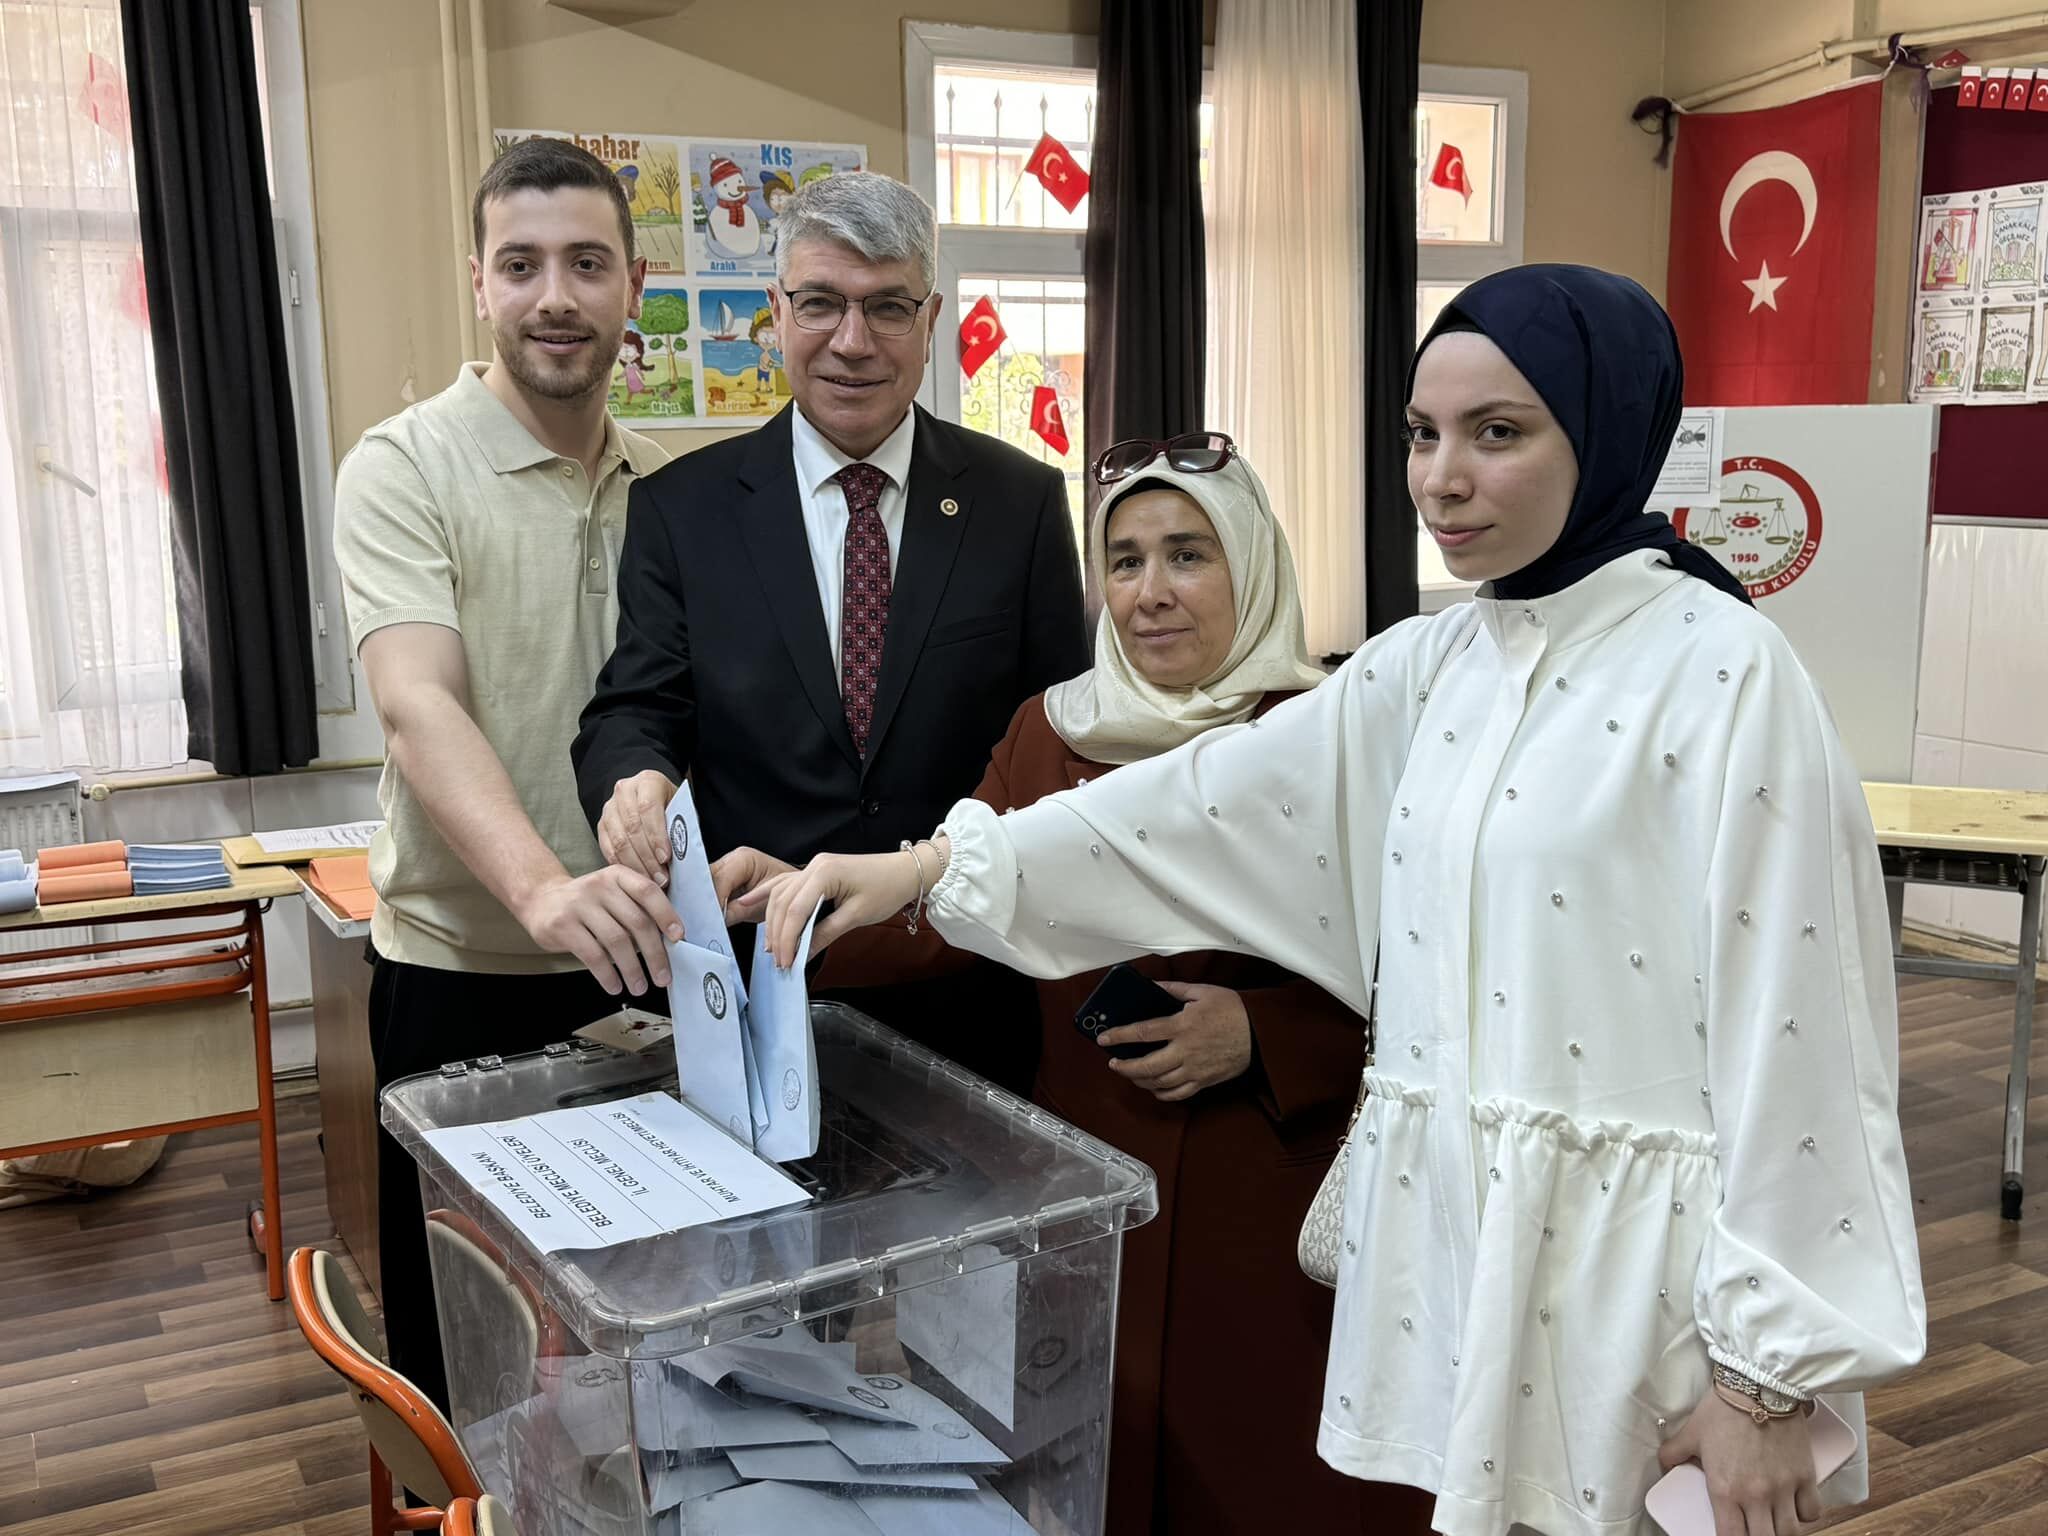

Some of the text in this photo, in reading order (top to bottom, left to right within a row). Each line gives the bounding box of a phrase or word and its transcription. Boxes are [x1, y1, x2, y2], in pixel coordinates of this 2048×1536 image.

[530, 134, 641, 160] bahar
[649, 261, 670, 270] asım
[1734, 458, 1762, 470] T.C.
[1731, 553, 1759, 562] 1950
[1771, 541, 1817, 591] KURULU
[566, 1138, 650, 1197] İL GENEL MECLİSİ
[689, 1168, 706, 1179] VE
[471, 1152, 551, 1219] BELEDİYE BAŞKANI
[496, 1135, 613, 1228] BELEDİYE MECLİSİ ÜYELERİ
[701, 1177, 741, 1203] MUHTAR
